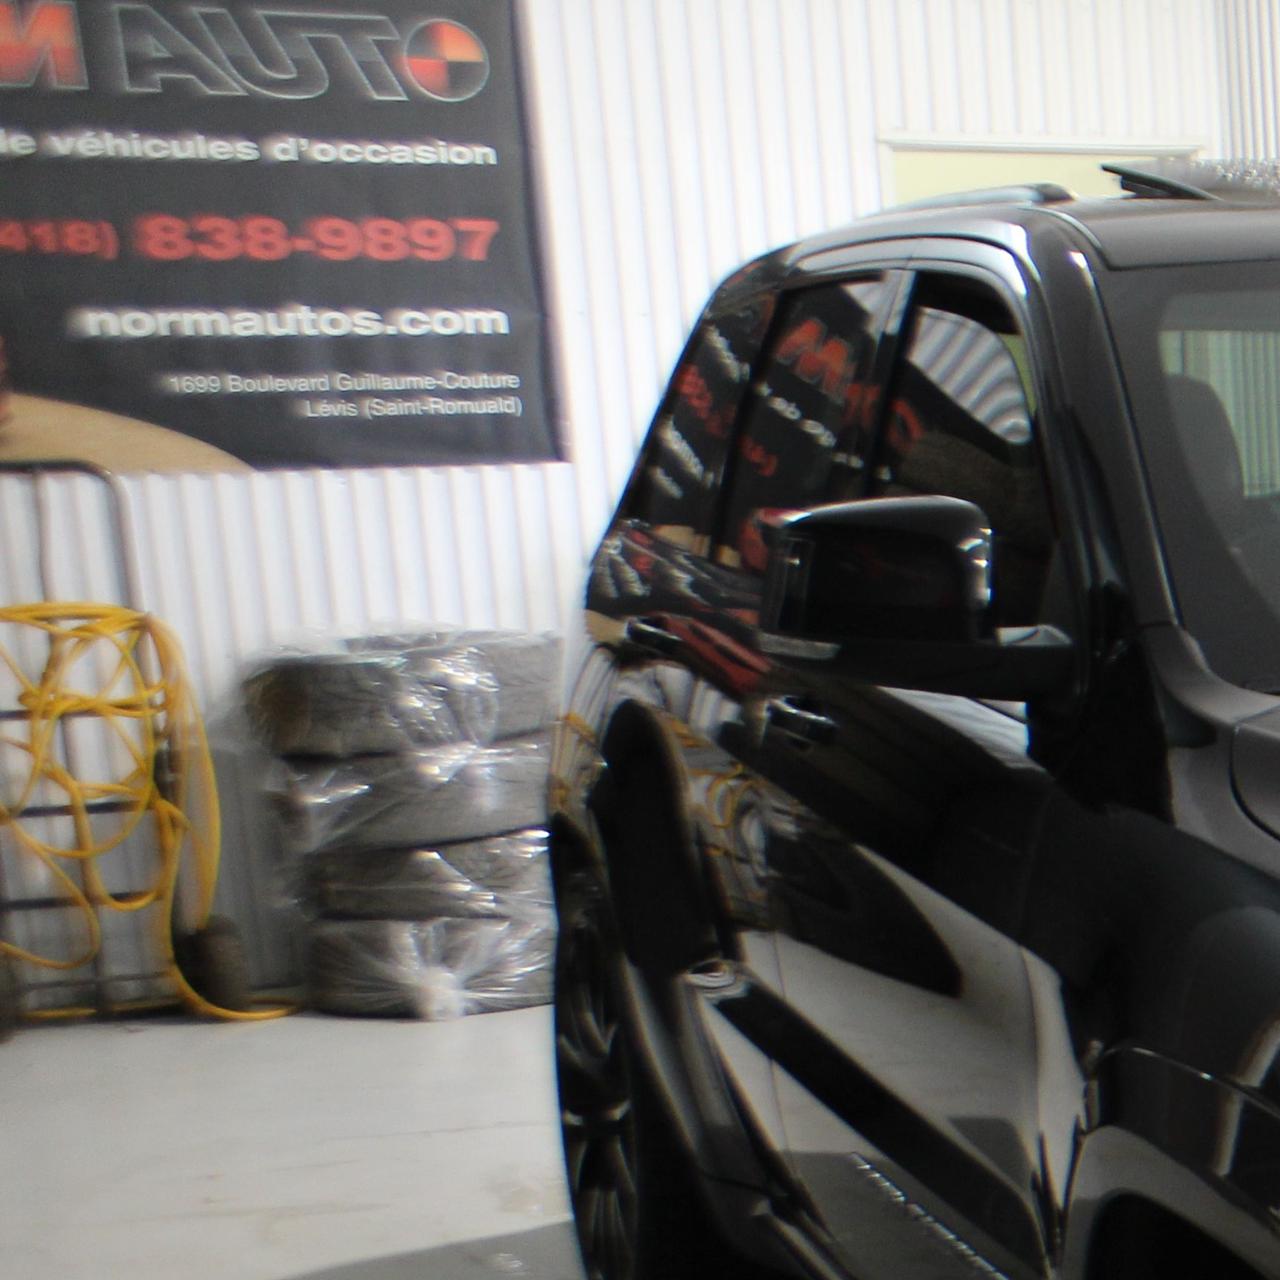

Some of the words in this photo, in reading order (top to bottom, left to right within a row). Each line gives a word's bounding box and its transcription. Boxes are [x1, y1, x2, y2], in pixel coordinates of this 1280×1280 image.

[50, 131, 261, 161] véhicules
[272, 137, 498, 165] d'occasion
[138, 215, 498, 261] 838-9897
[87, 306, 510, 337] normautos.com
[169, 375, 221, 394] 1699
[228, 374, 330, 393] Boulevard
[335, 371, 521, 391] Guillaume-Couture
[306, 399, 358, 417] Lévis
[365, 396, 523, 419] (Saint-Romuald)
